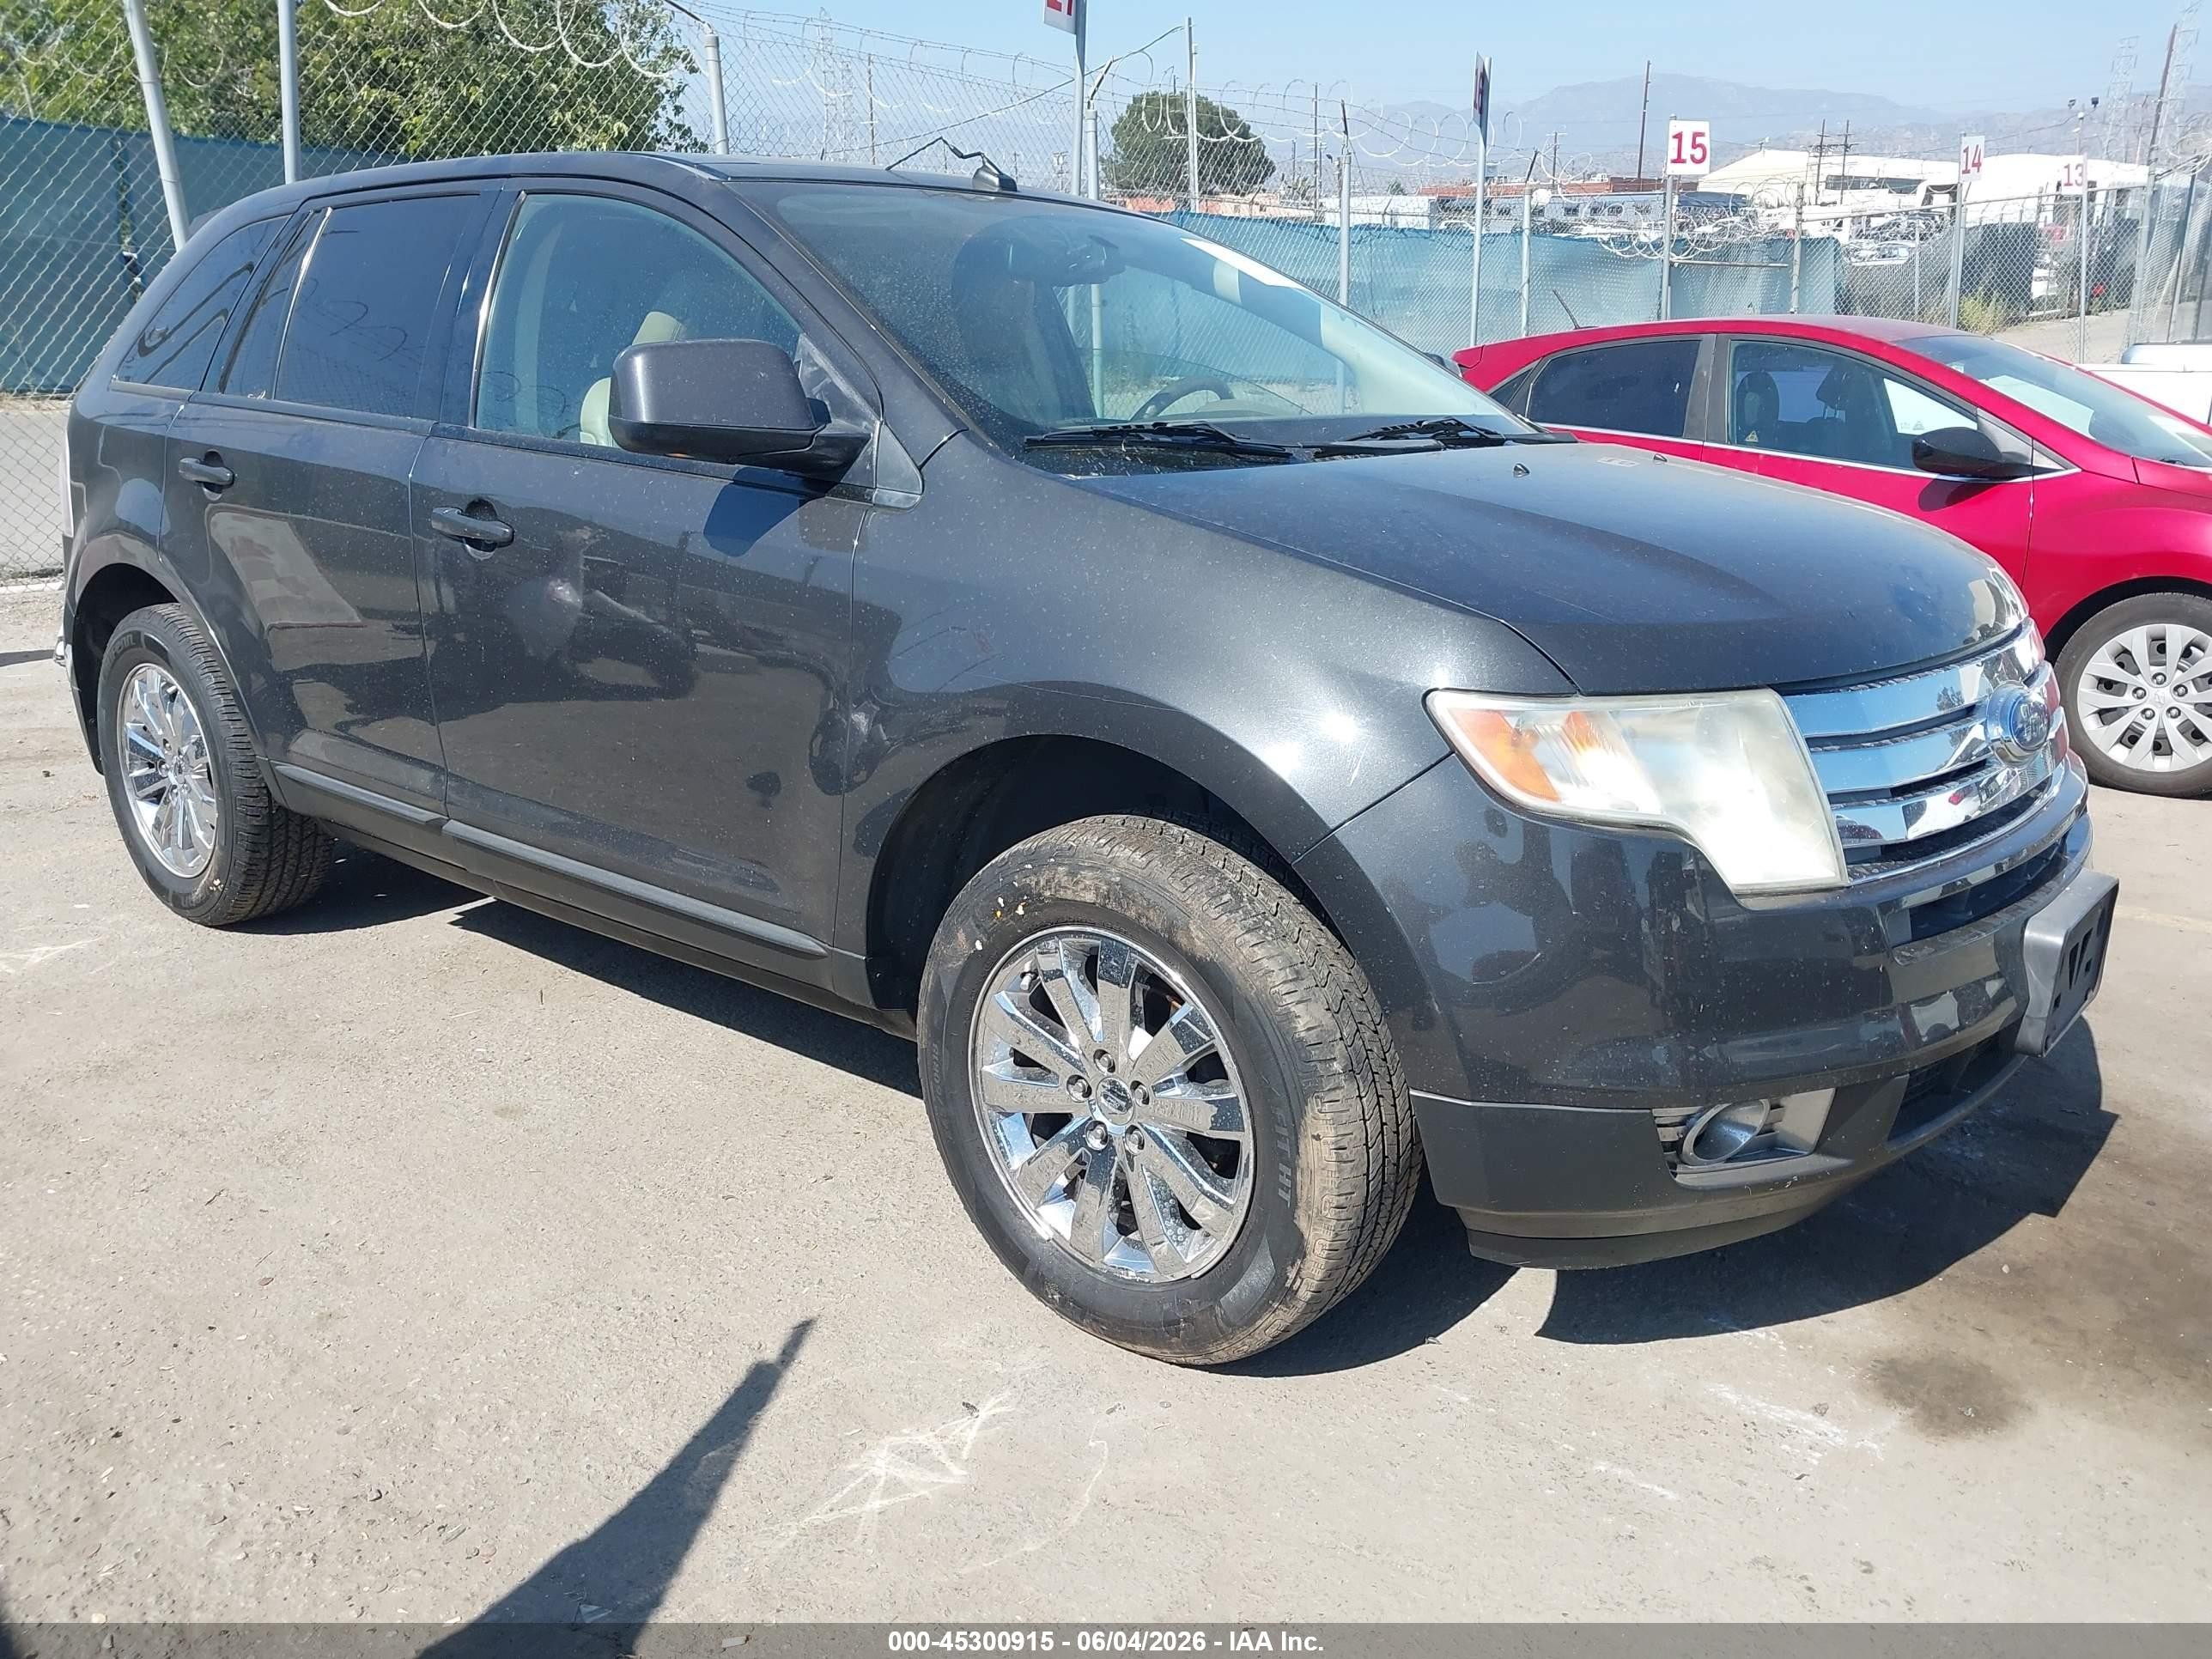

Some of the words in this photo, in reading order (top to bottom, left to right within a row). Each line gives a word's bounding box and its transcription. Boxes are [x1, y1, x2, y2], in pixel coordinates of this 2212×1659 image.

[1670, 131, 1707, 164] 15
[1961, 144, 1982, 174] 14
[2063, 163, 2083, 186] 13
